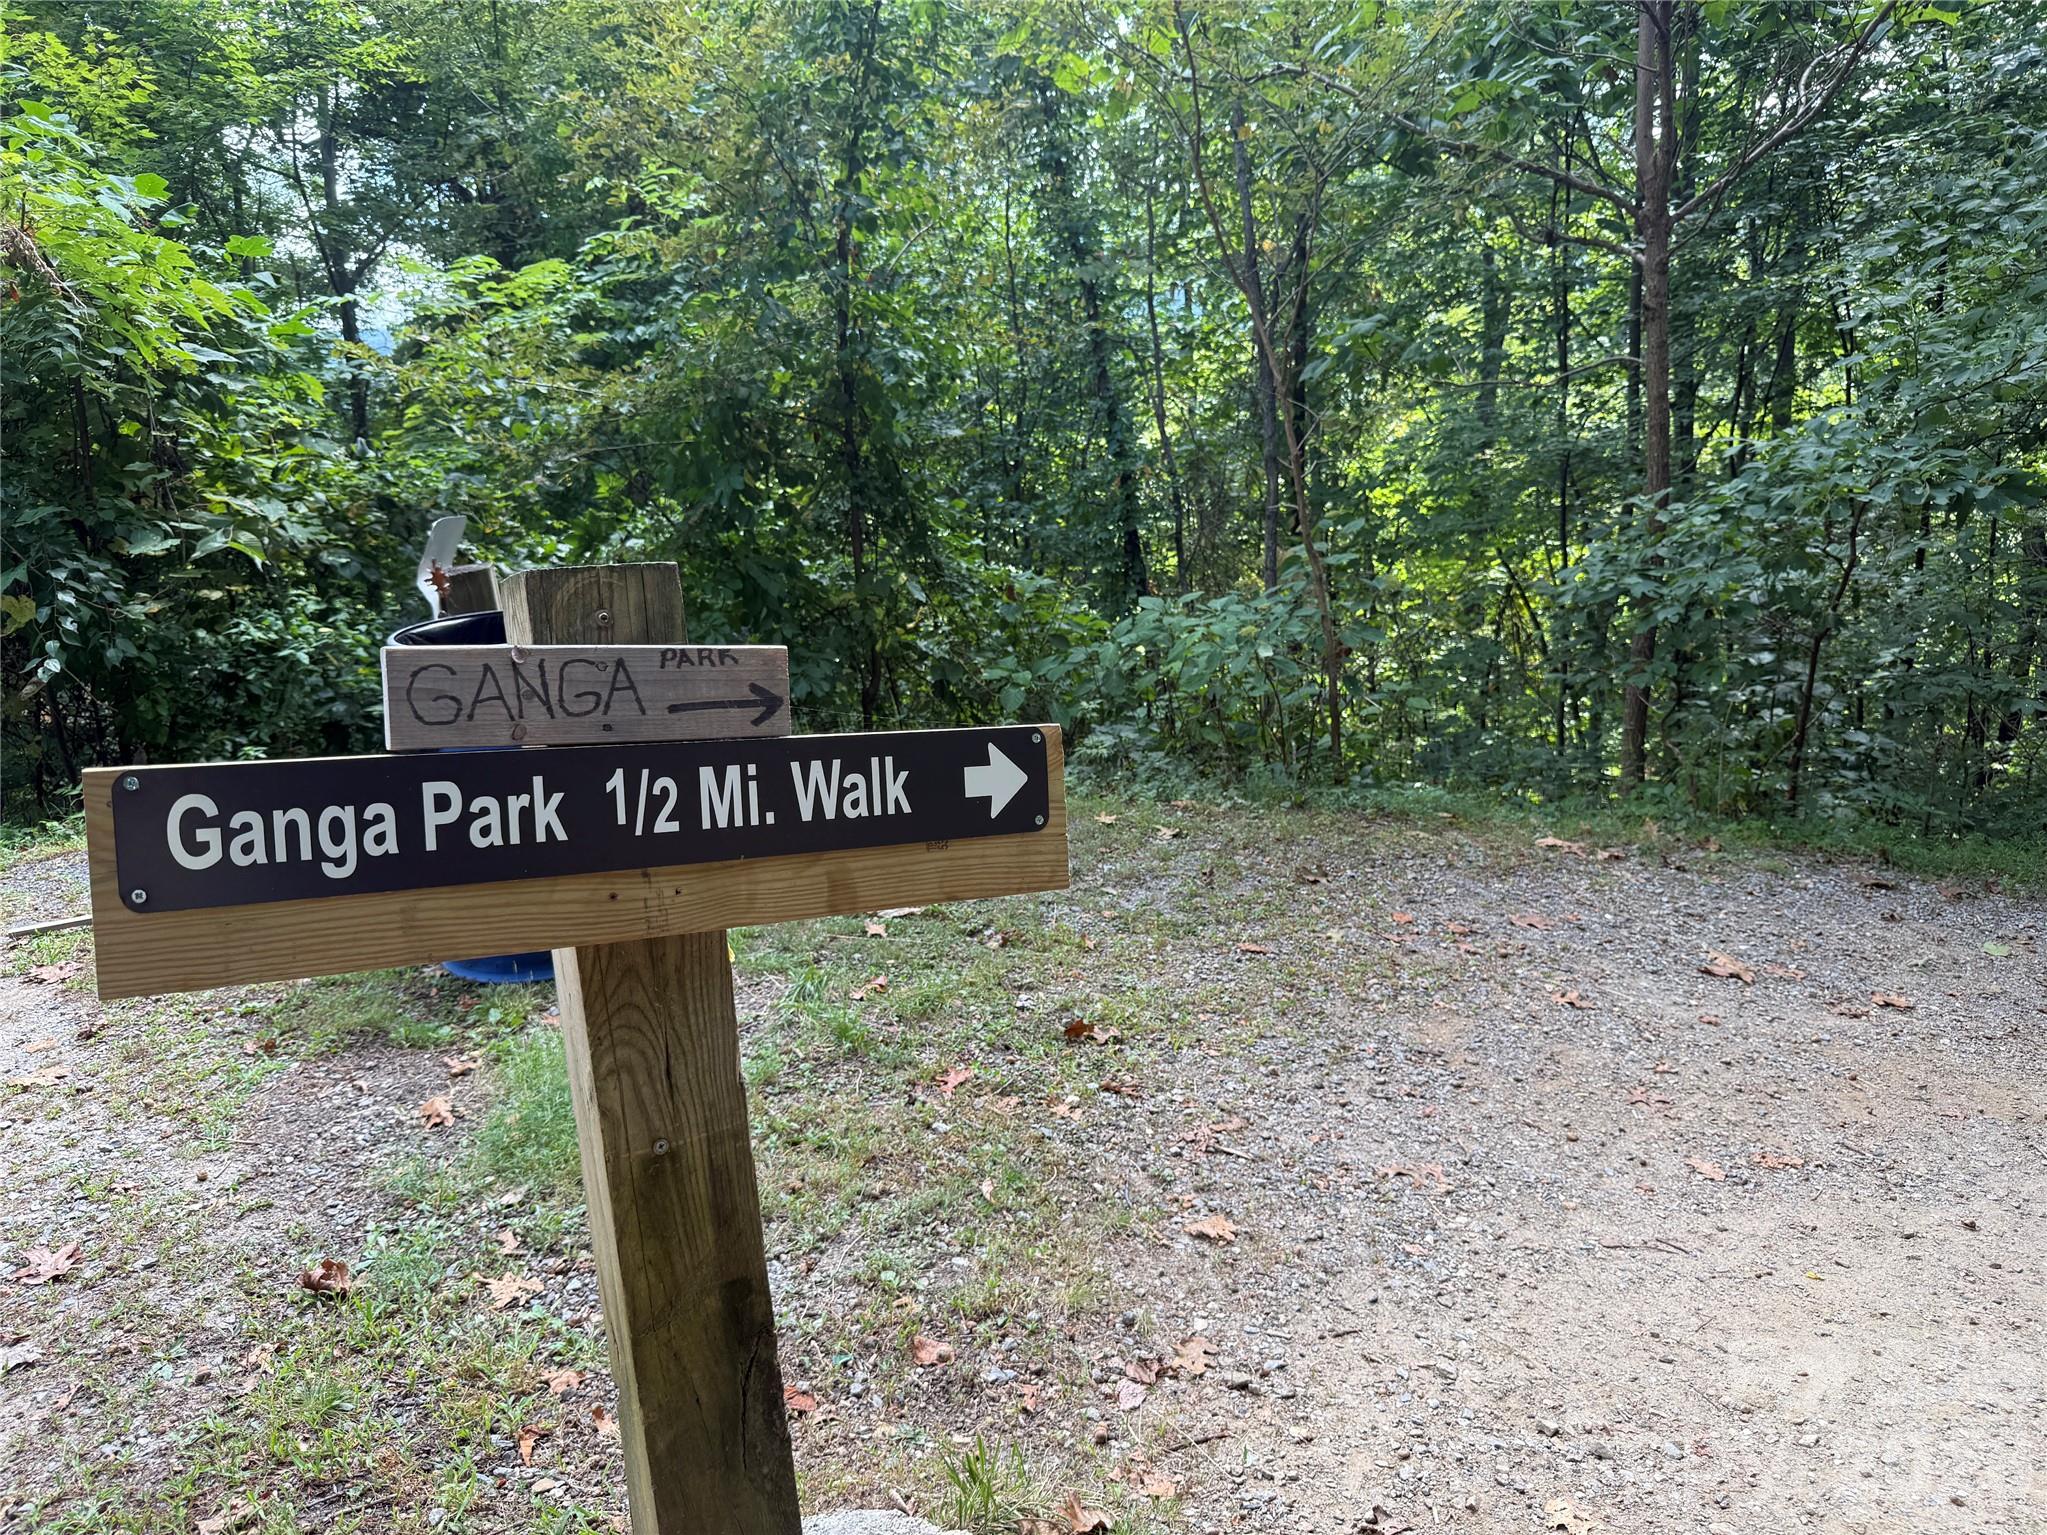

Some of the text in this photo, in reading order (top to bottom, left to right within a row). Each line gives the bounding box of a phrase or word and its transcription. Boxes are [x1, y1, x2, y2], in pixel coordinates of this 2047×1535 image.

[406, 657, 647, 726] GANGA
[660, 647, 739, 669] PARK
[166, 755, 912, 879] Ganga Park 1/2 Mi. Walk
